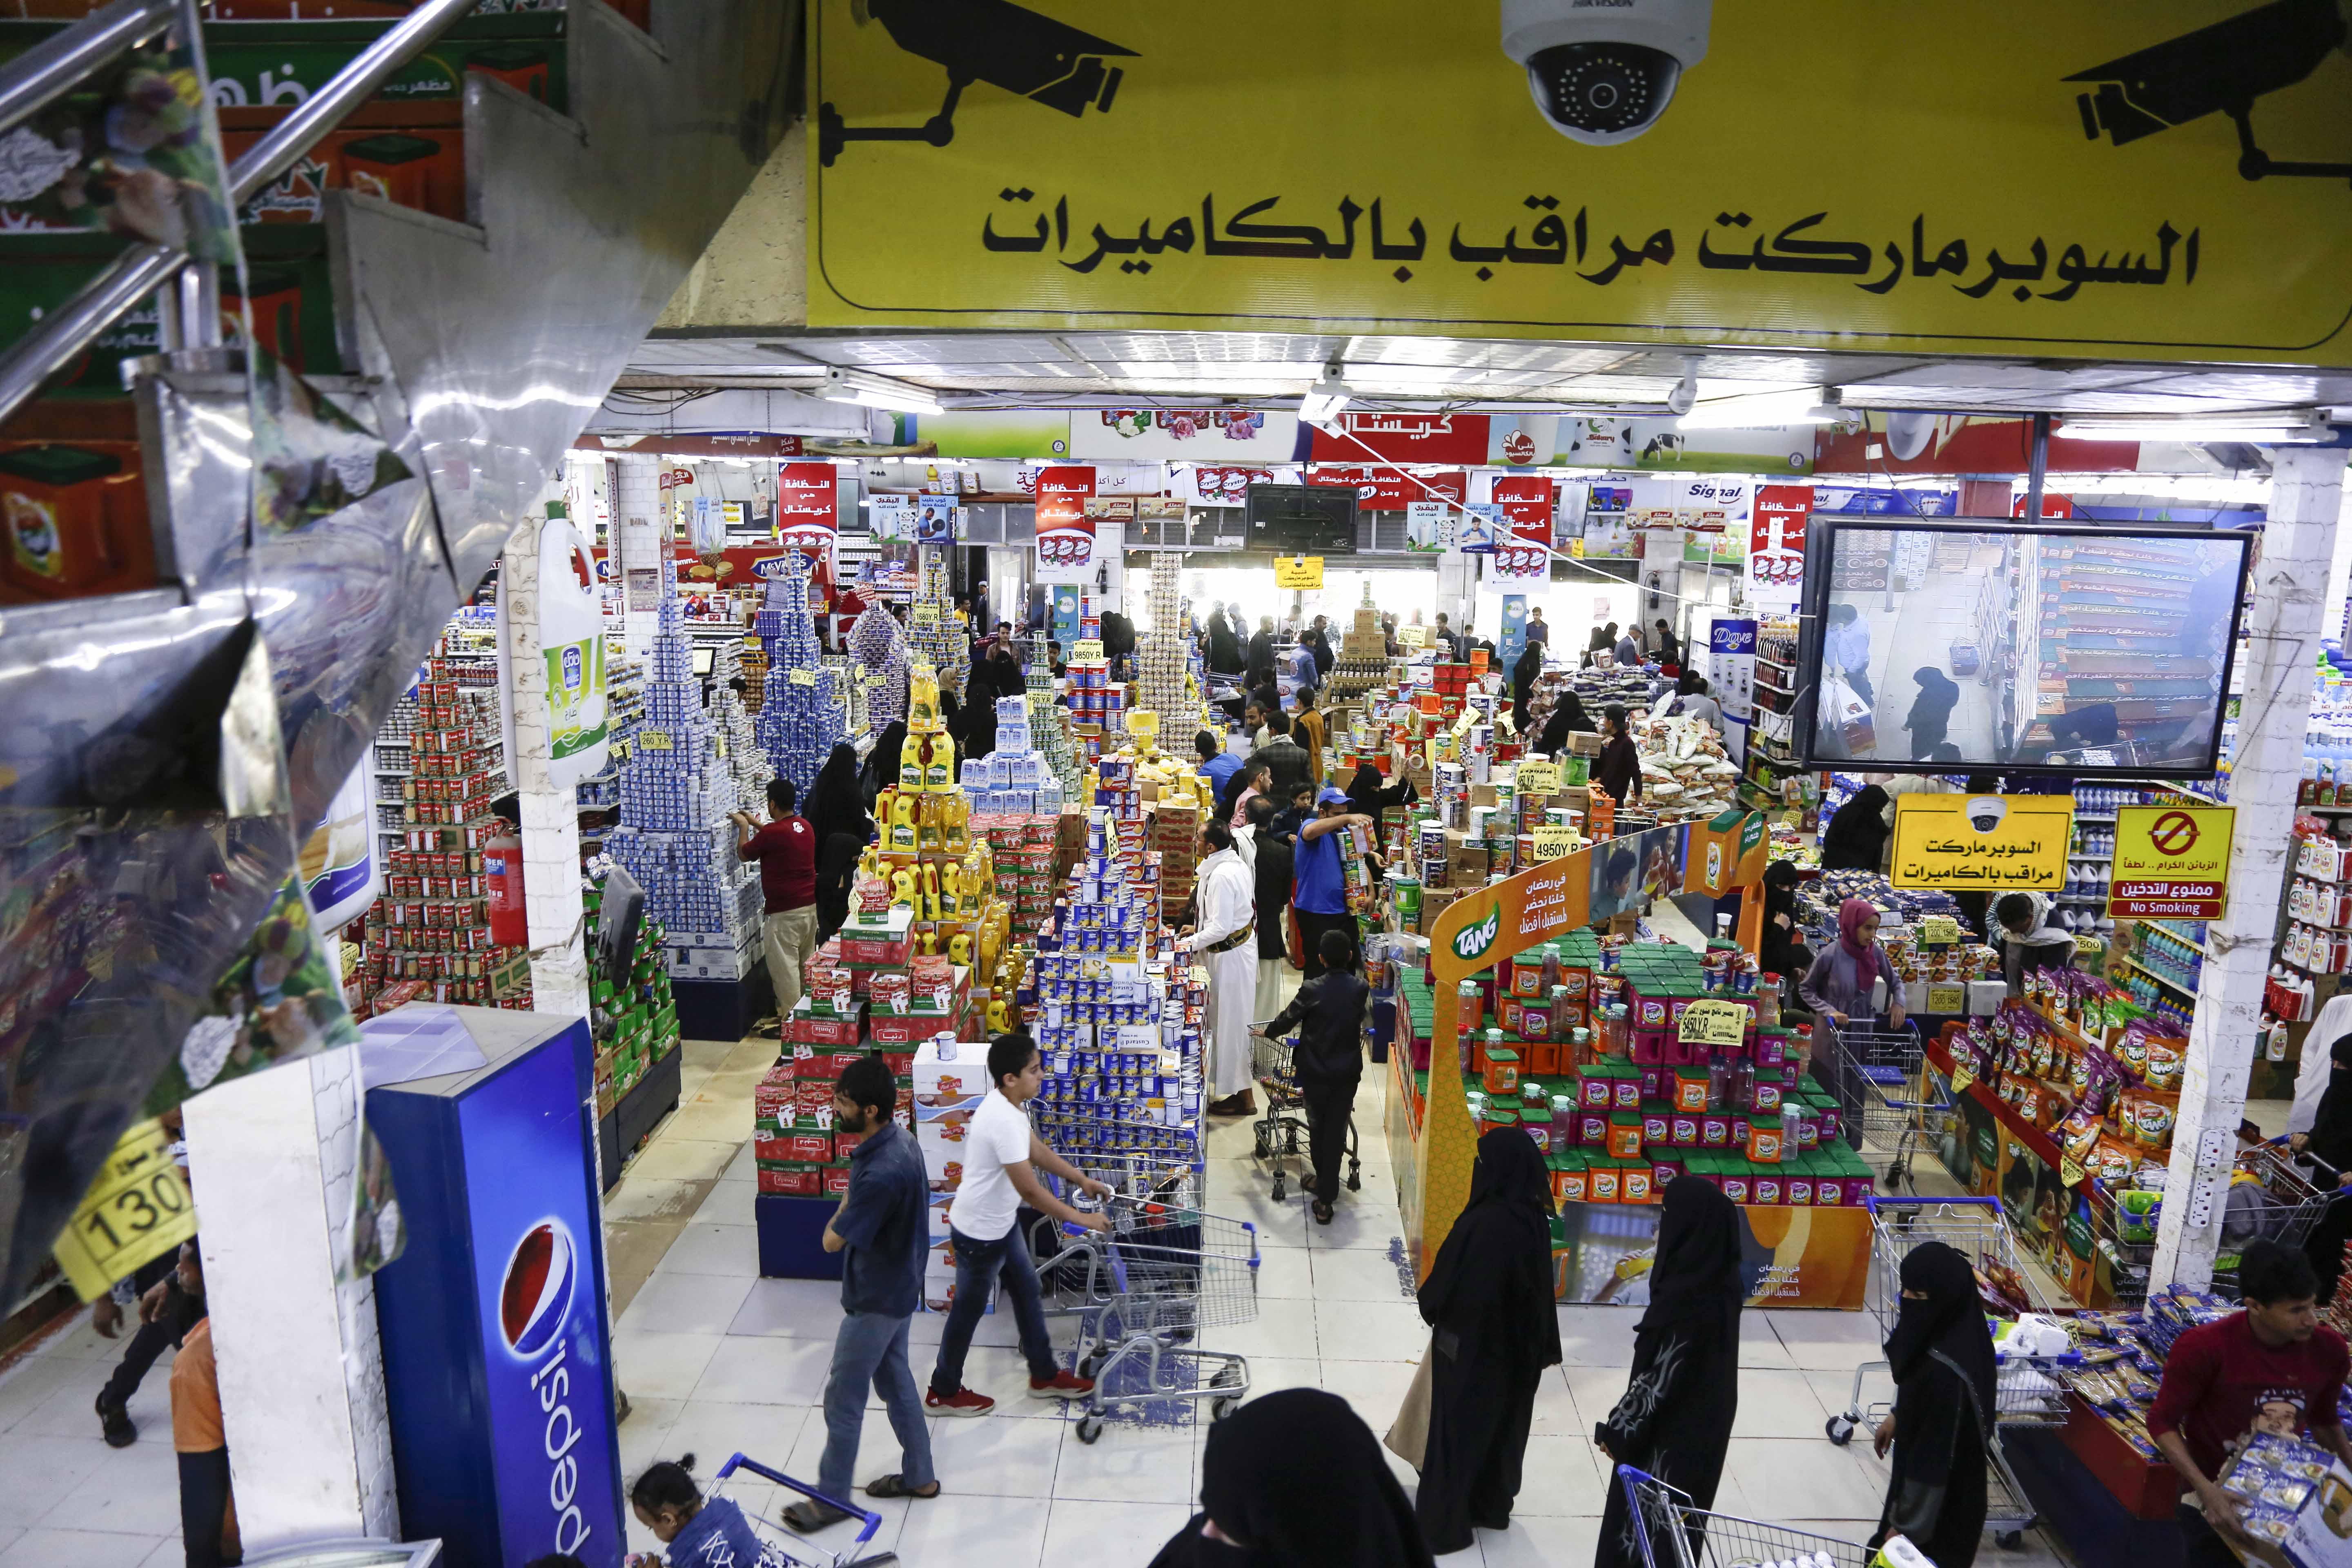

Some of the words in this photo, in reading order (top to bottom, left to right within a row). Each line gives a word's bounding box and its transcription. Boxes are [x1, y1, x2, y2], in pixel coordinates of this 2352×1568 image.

[982, 187, 1427, 283] بالكاميرات
[1448, 194, 1677, 287] مراقب
[784, 479, 830, 489] النظافة
[1042, 483, 1089, 492] النظافة
[1223, 477, 1246, 488] Crystal
[1498, 493, 1544, 503] النظافة
[784, 504, 831, 516] كريستال
[1760, 501, 1805, 512] النظافة
[1041, 508, 1085, 520] ريستال
[1714, 627, 1753, 644] Dove
[2156, 860, 2184, 872] الكرام
[1554, 872, 1566, 890] في
[1903, 864, 2001, 884] بالكاميرات
[2005, 865, 2054, 884] مراقب
[1526, 878, 1553, 895] رمضان
[2121, 882, 2168, 898] التدخين
[2169, 885, 2214, 899] ممنوع
[1548, 891, 1565, 905] خلنا
[2130, 901, 2147, 912] No
[2149, 902, 2201, 916] Smoking
[1519, 910, 1541, 934] أفضل
[1456, 913, 1497, 956] TANG
[882, 1031, 903, 1041] دنيا
[2127, 1047, 2146, 1059] TANG
[2150, 1062, 2174, 1074] TANG
[2141, 1118, 2166, 1132] TANG
[87, 1172, 184, 1248] 130
[1758, 1264, 1787, 1274] رمضان
[1788, 1264, 1800, 1275] في
[1751, 1283, 1773, 1297] أفضل
[531, 1351, 591, 1557] pepsi
